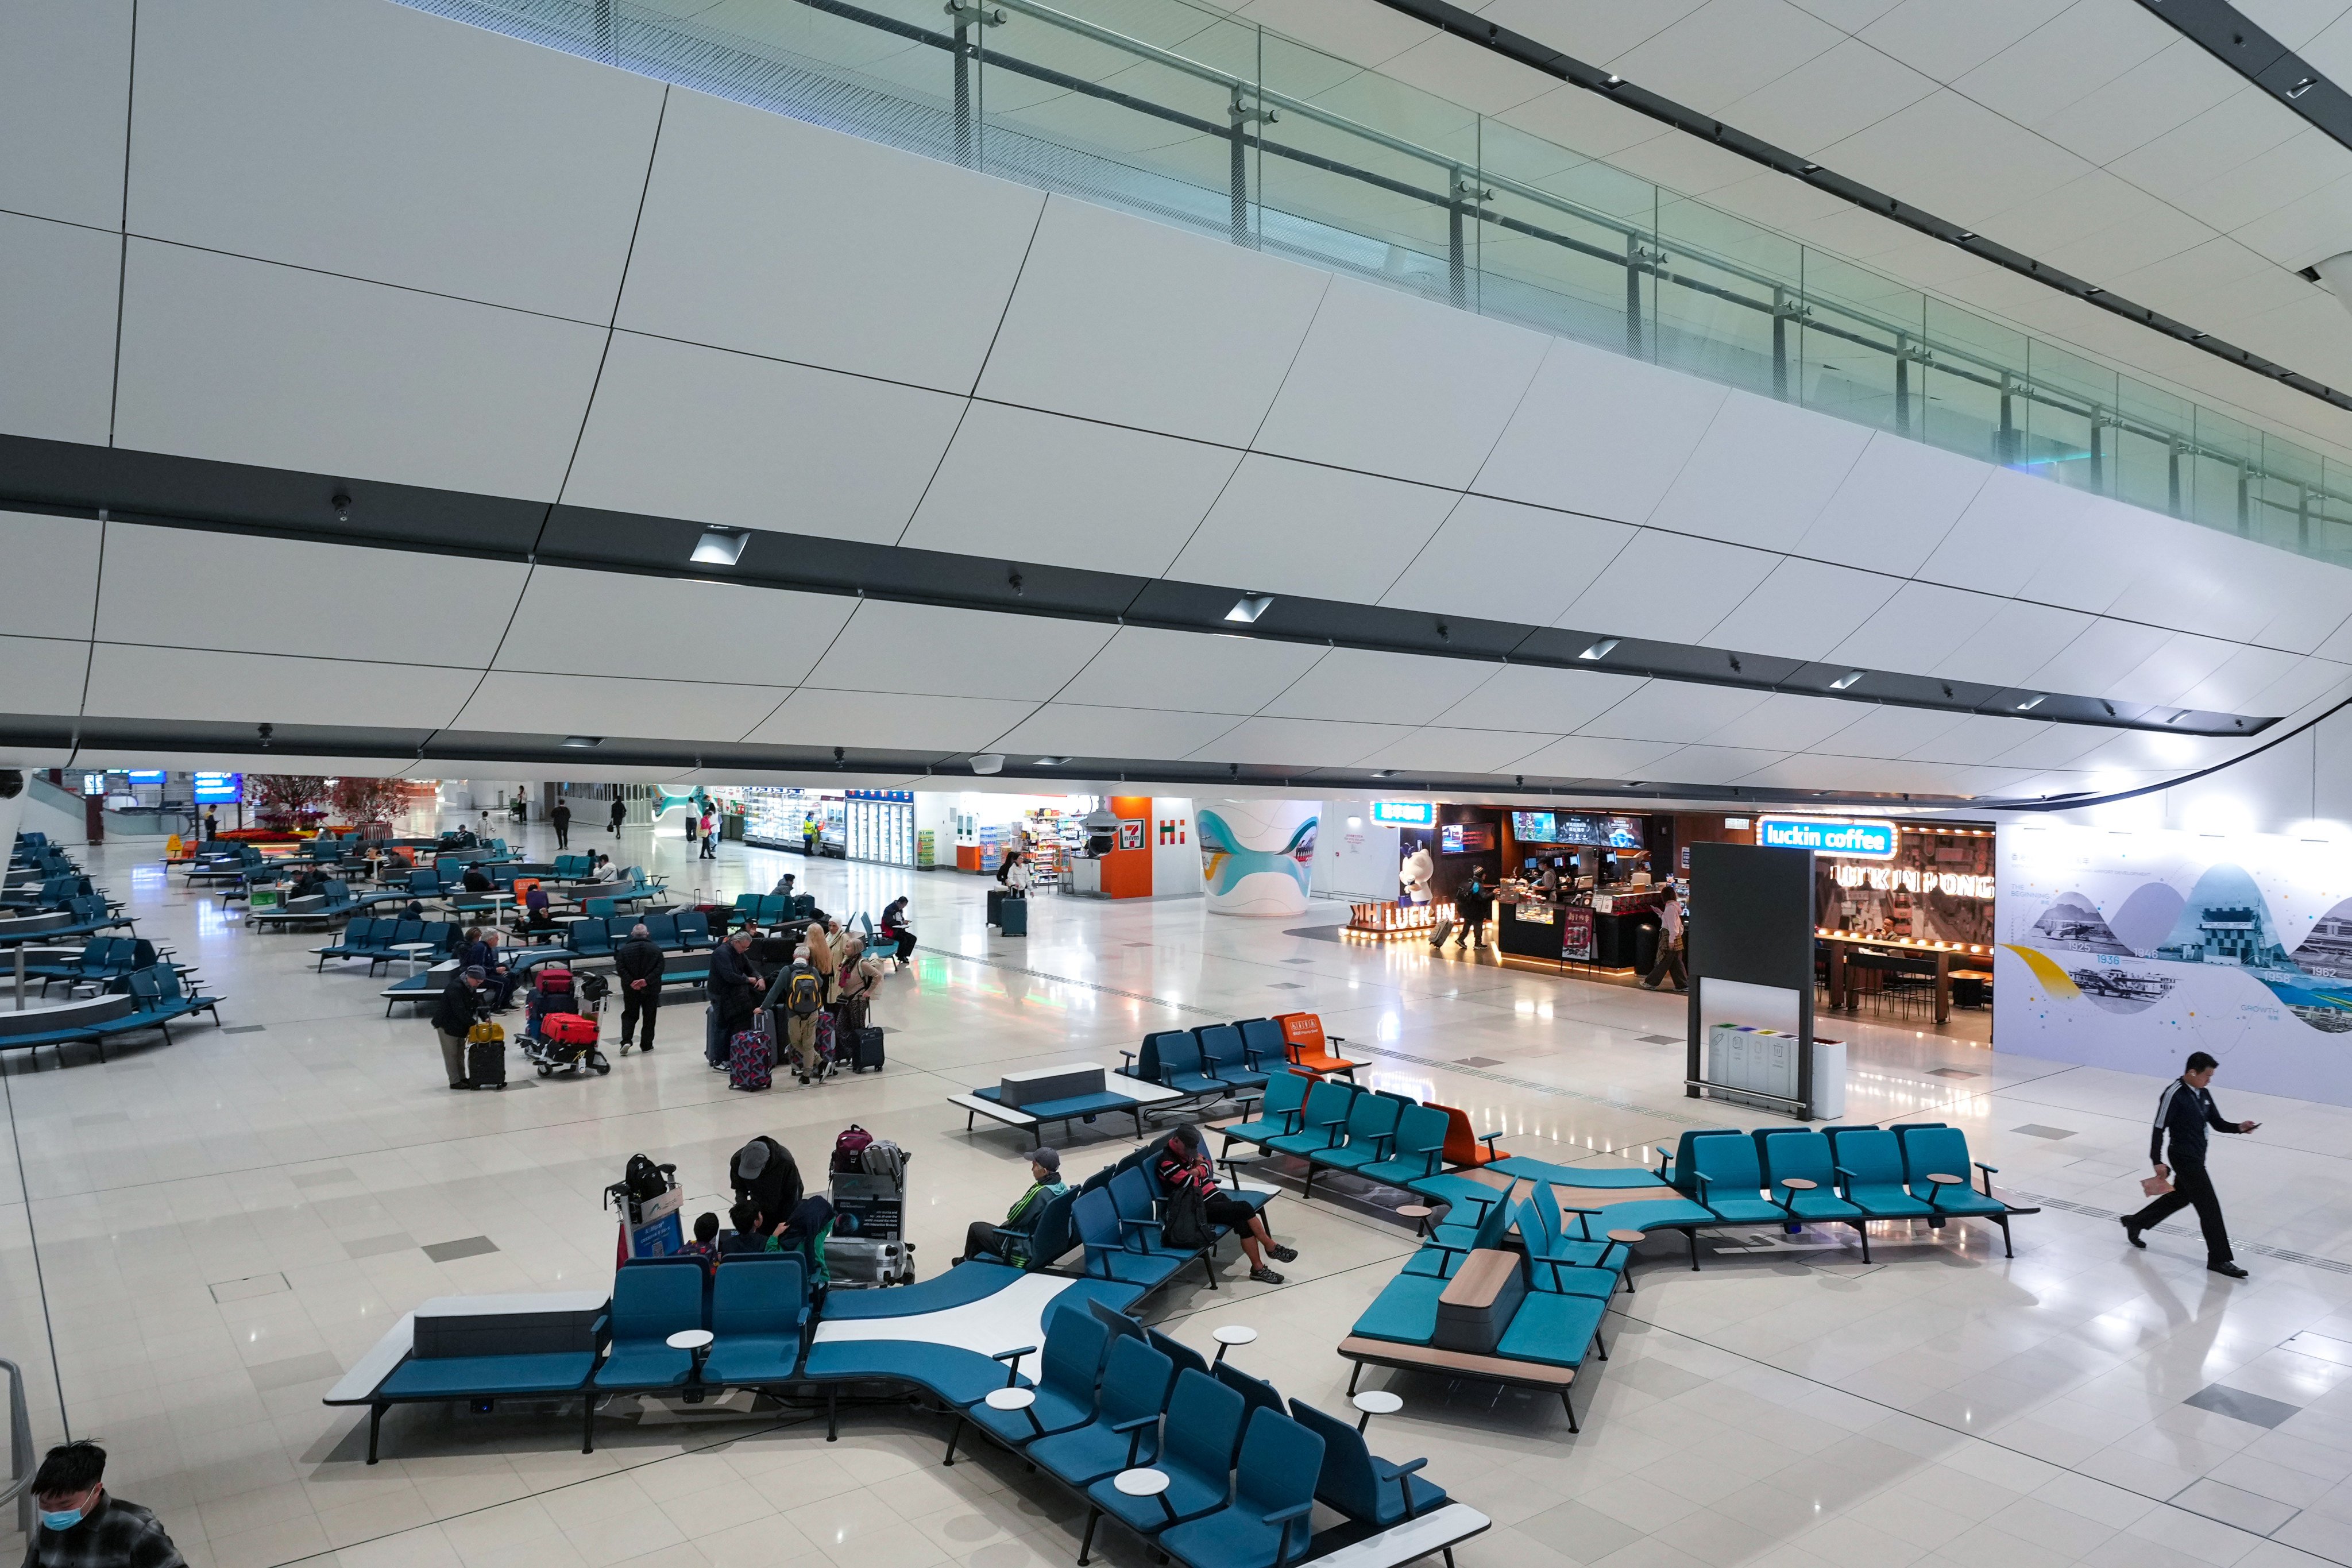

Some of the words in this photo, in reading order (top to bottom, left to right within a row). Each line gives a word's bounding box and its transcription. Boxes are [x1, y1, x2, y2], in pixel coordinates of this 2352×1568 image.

[1125, 825, 1138, 847] 7
[1160, 820, 1185, 845] Hi
[1767, 825, 1821, 846] luckin
[1825, 828, 1884, 850] coffee
[2011, 891, 2049, 899] BEGINNING
[2068, 941, 2091, 952] 1925
[2134, 948, 2158, 959] 1946
[2264, 971, 2291, 983] 1958
[2312, 967, 2336, 978] 1962
[2241, 1005, 2278, 1014] GROWTH
